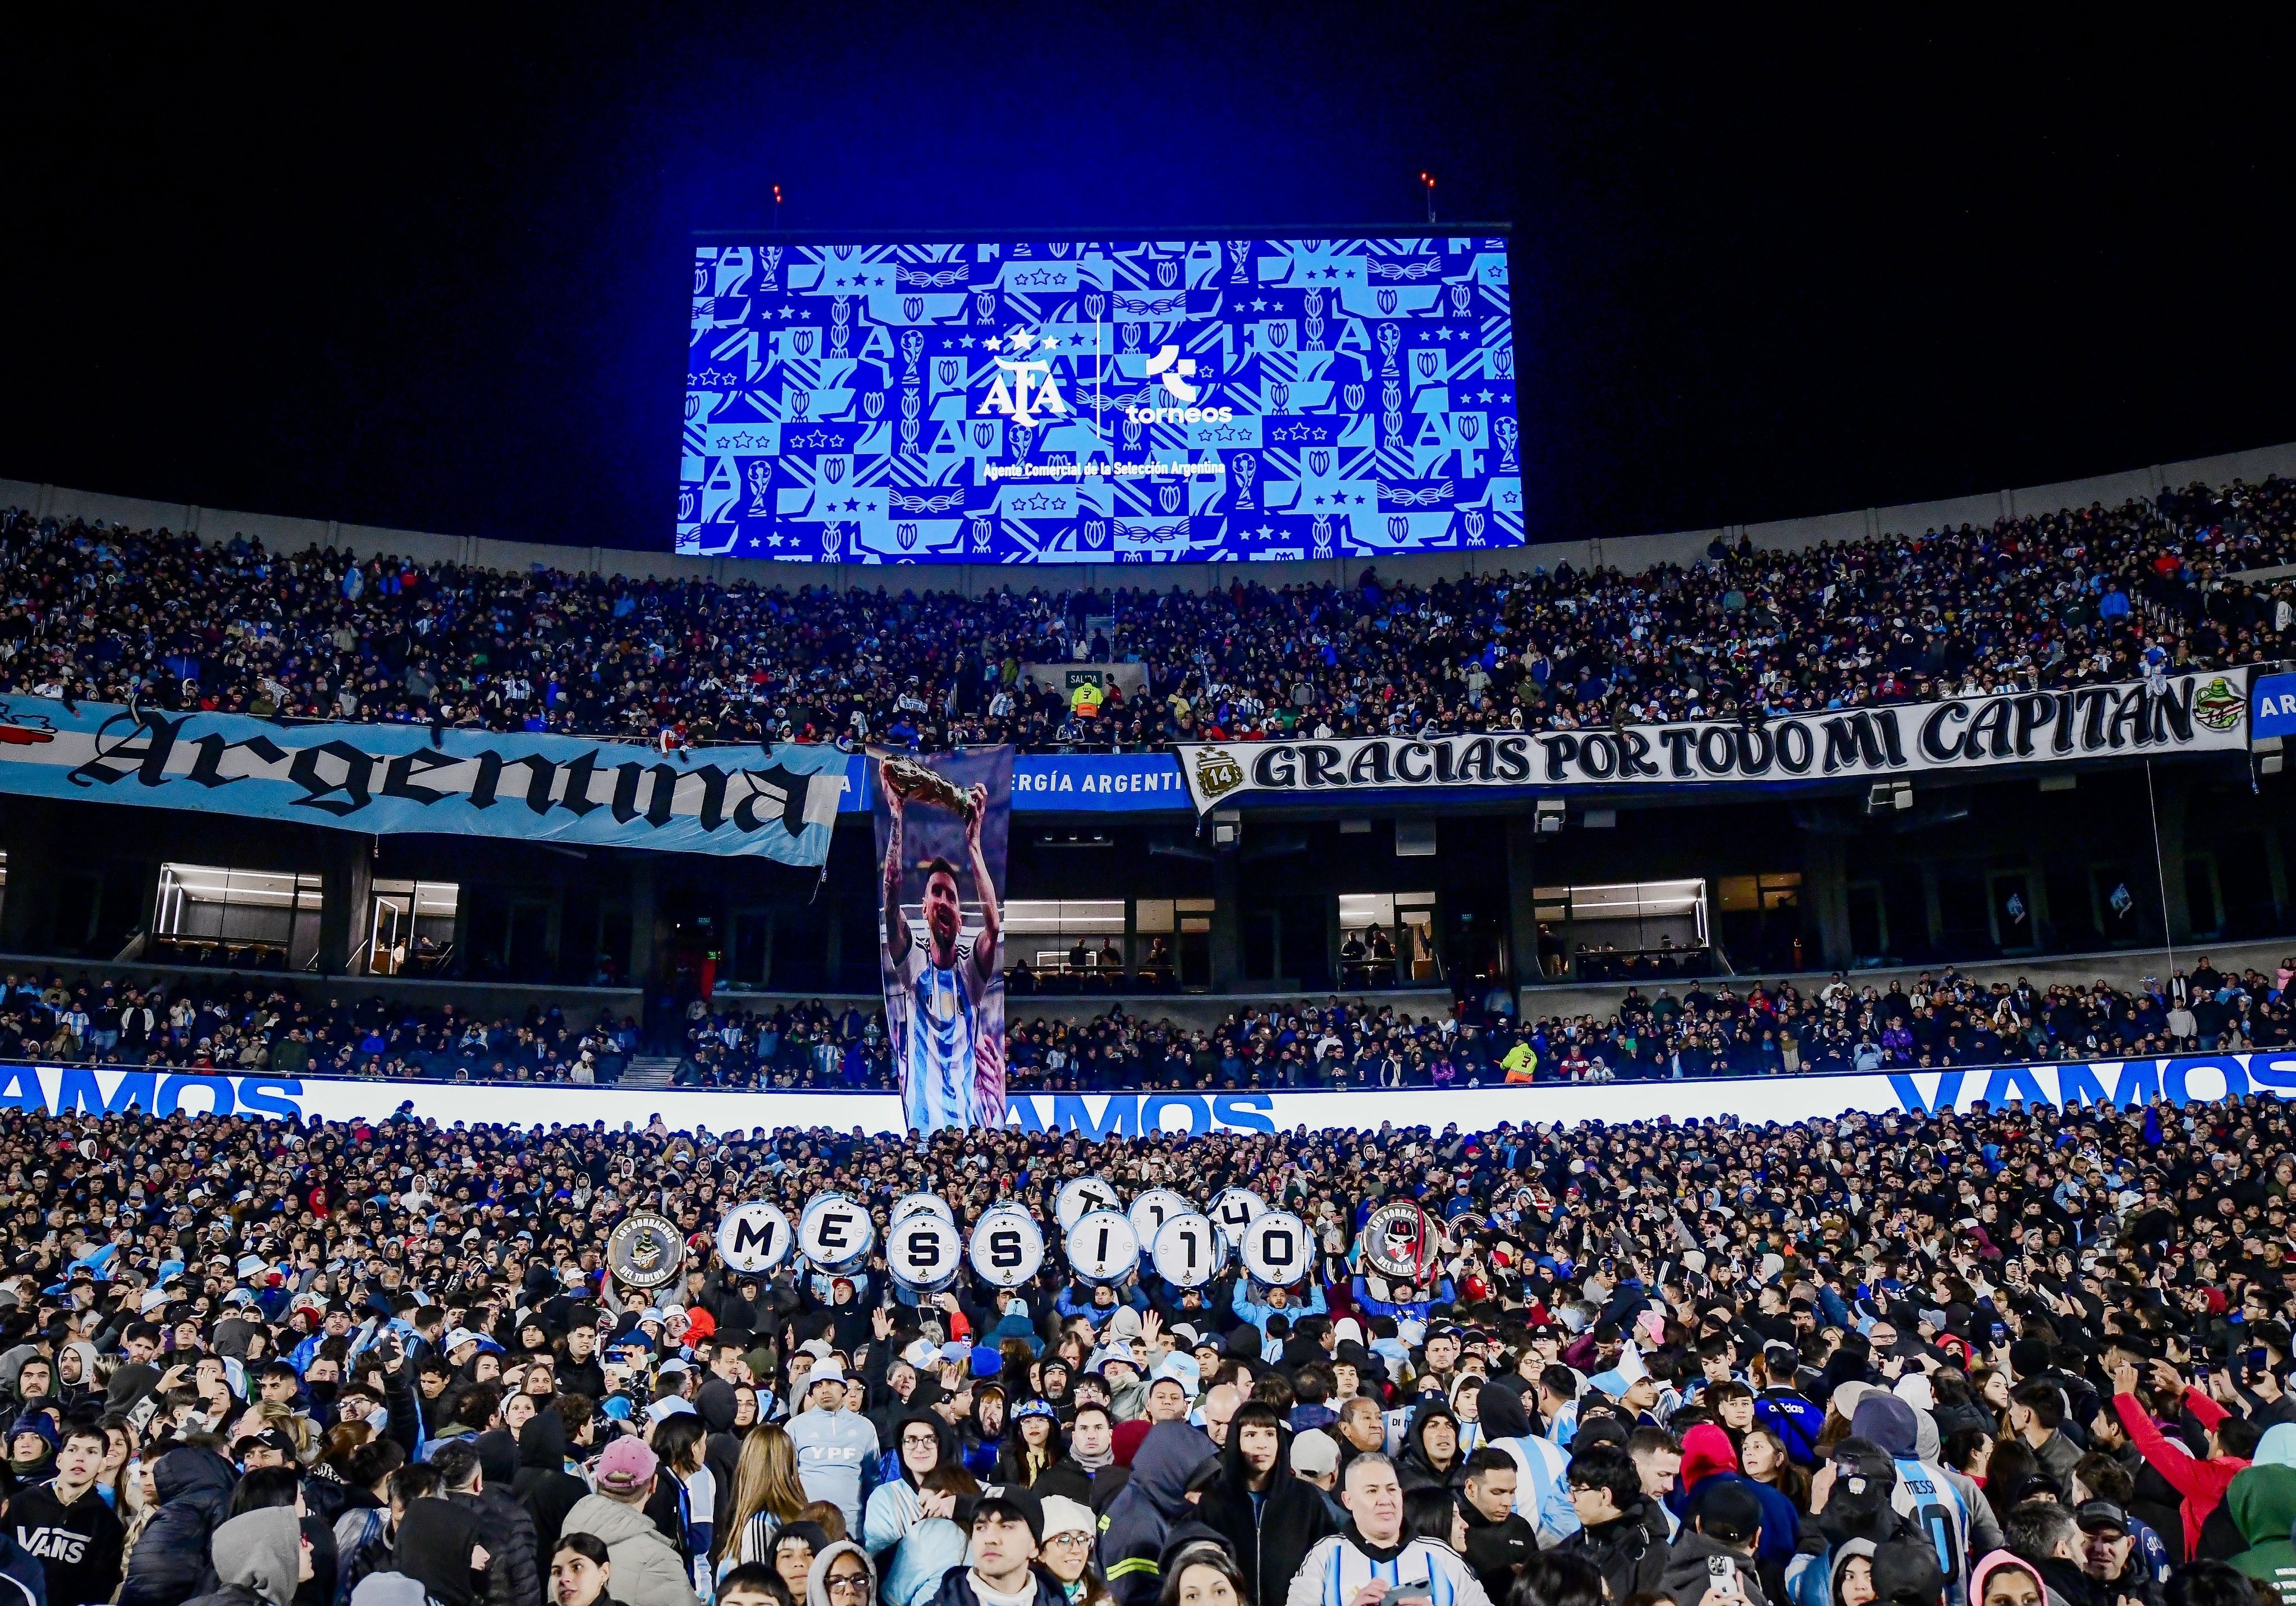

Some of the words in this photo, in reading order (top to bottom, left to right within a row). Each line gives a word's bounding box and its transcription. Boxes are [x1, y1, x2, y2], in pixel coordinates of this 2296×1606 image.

[1125, 405, 1233, 424] torneos
[983, 463, 1023, 481] Agente
[1024, 463, 1081, 476] Comercial
[1085, 462, 1099, 475] de
[1100, 461, 1112, 475] la
[1113, 460, 1168, 475] Selección
[1170, 460, 1225, 477] Argentina
[1083, 690, 1091, 699] 3
[1251, 737, 1530, 787] GRACIAS
[1540, 732, 1660, 781] POR
[1659, 721, 1813, 779] TODO
[1823, 709, 1909, 774] MI
[67, 711, 822, 839] Argentina
[1210, 766, 1232, 786] 14
[1521, 1055, 1531, 1068] 3
[1886, 1053, 2296, 1119] VAMOS
[1005, 1094, 1275, 1142] AMOS
[1078, 1189, 1104, 1218] T
[1221, 1202, 1251, 1228] 4
[616, 1225, 632, 1241] LOS
[630, 1218, 677, 1244] BORRACHOS
[1370, 1215, 1384, 1231] LOS
[1382, 1208, 1431, 1233] BORRACS
[733, 1218, 775, 1256] M
[817, 1214, 853, 1248] E
[908, 1232, 939, 1266] S
[990, 1231, 1022, 1268] S
[619, 1265, 635, 1280] DEL
[634, 1268, 666, 1283] TABLON
[1376, 1255, 1392, 1270] DEL
[811, 1446, 856, 1459] YPF
[1904, 1480, 1937, 1495] MESSI
[16, 1525, 93, 1564] VANS
